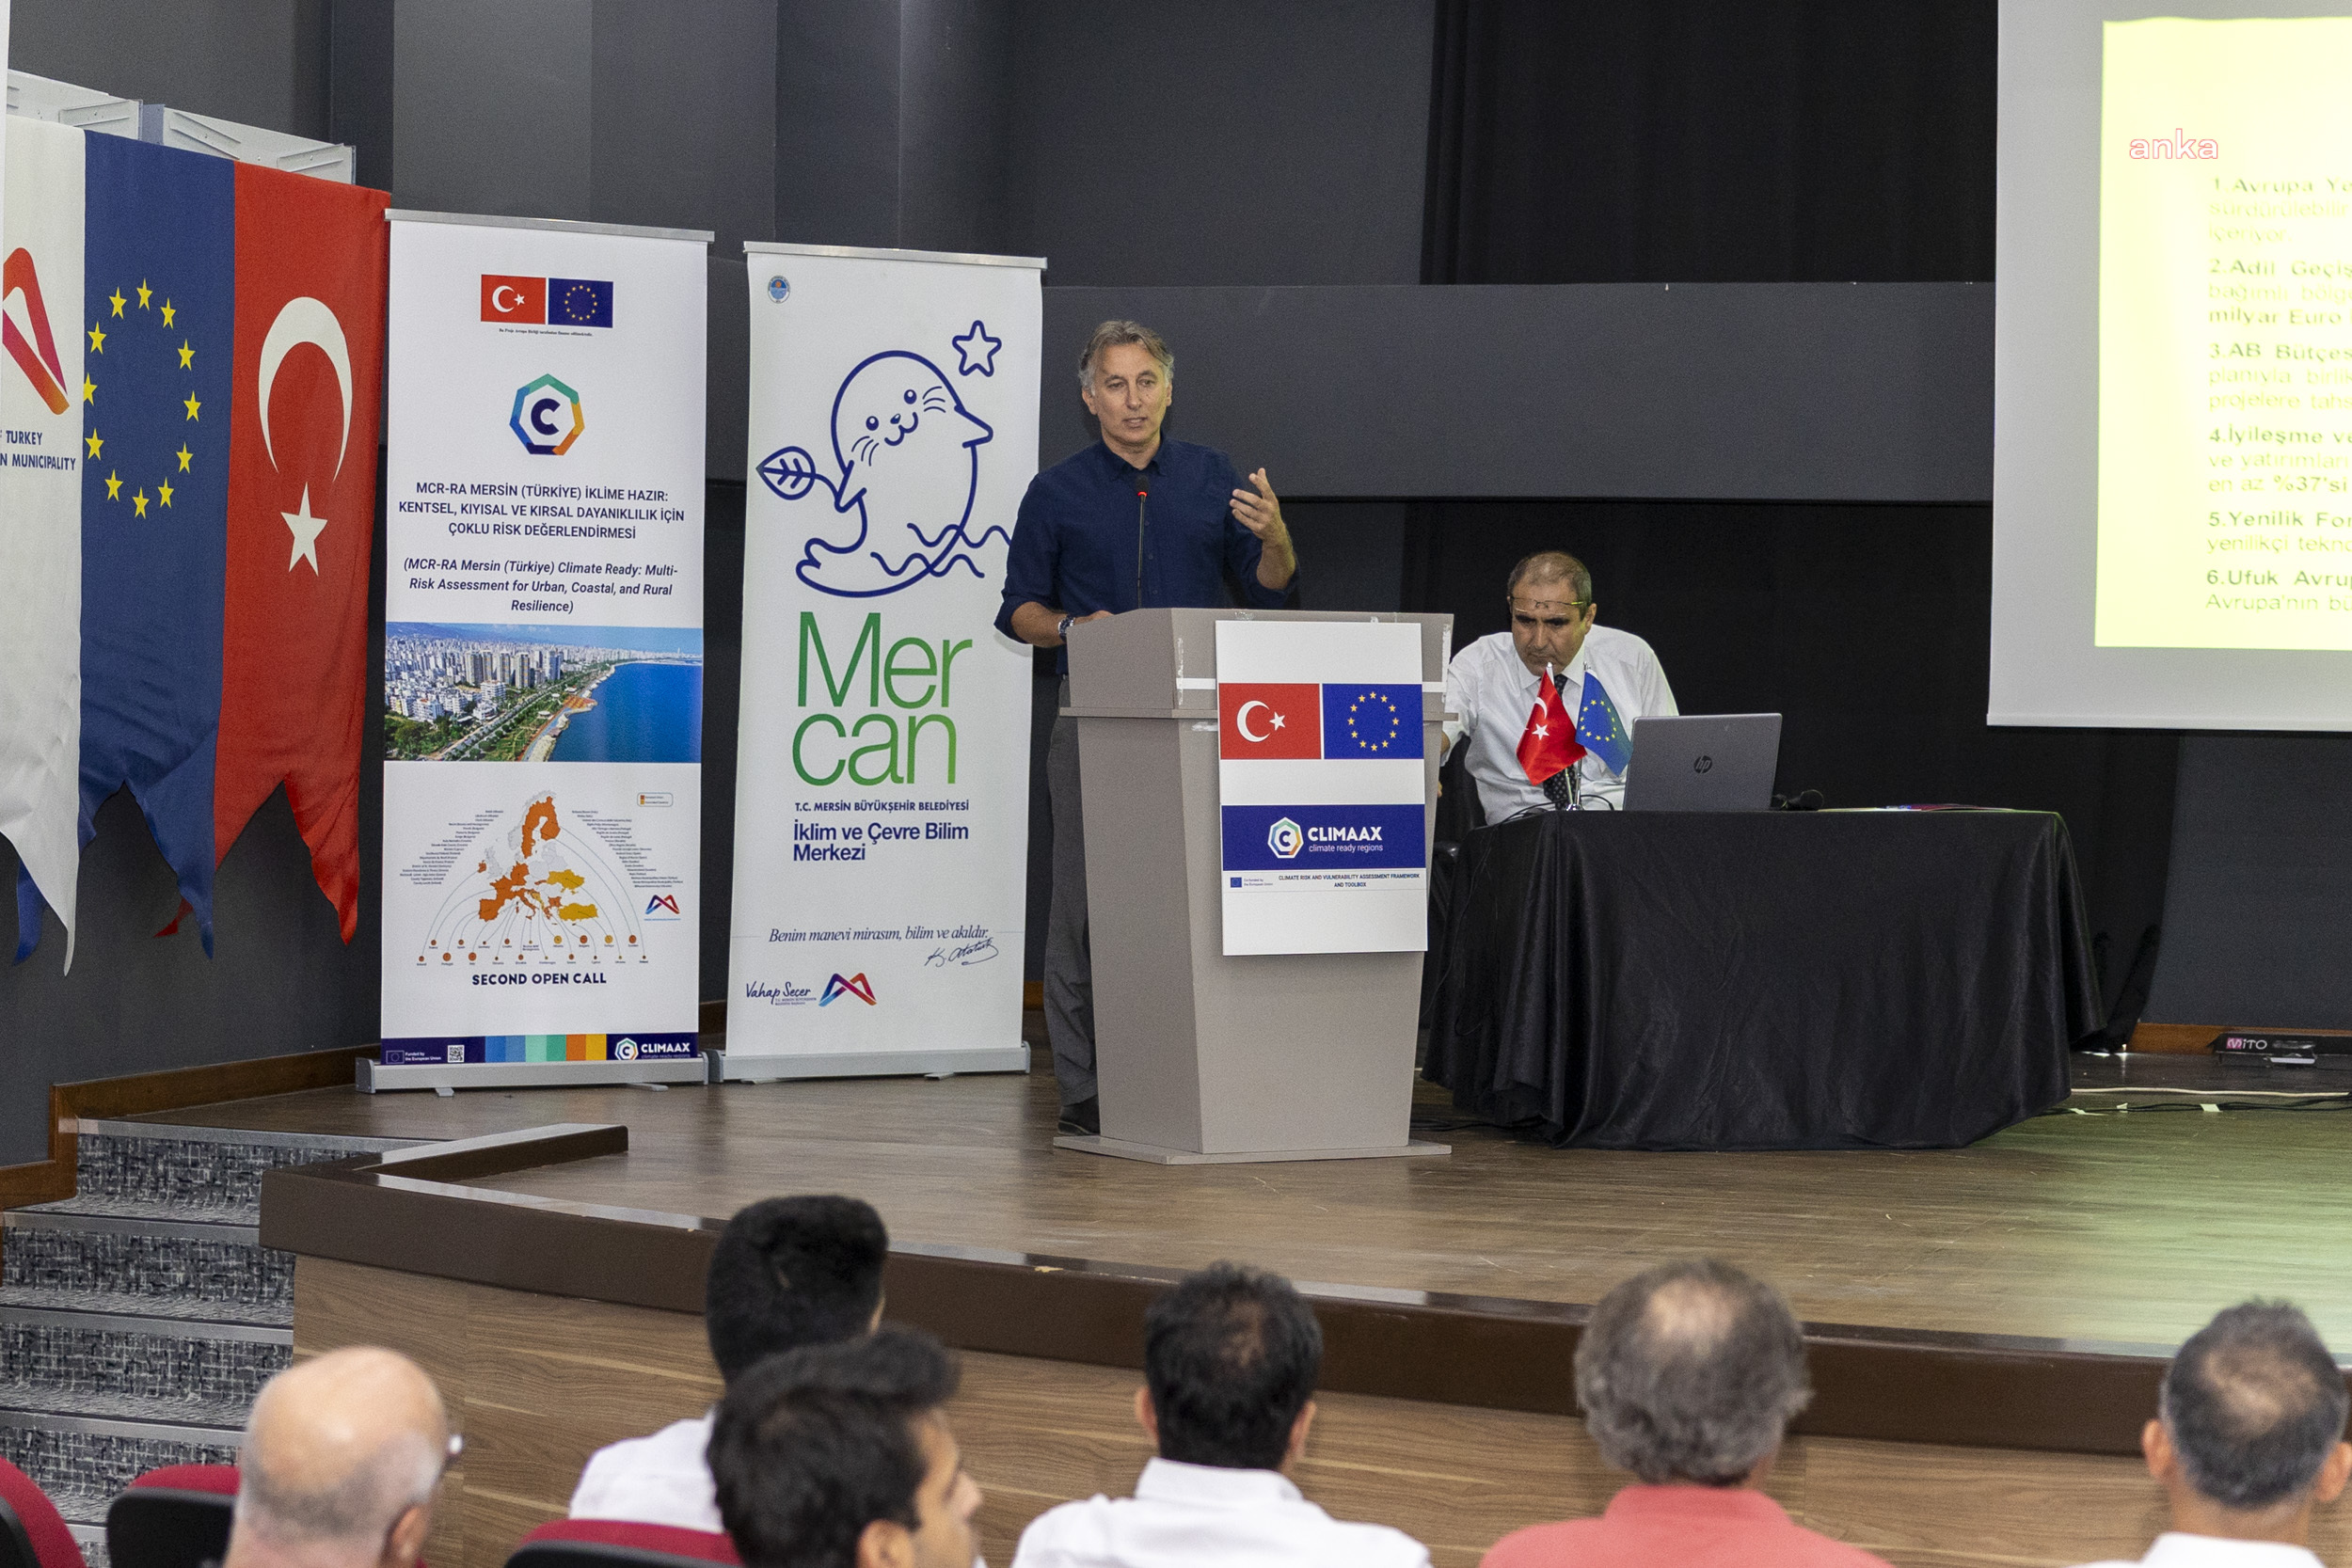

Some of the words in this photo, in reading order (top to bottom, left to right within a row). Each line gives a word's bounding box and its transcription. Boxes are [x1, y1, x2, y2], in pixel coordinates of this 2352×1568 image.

[2211, 175, 2314, 197] 1.Avrupa
[2209, 201, 2349, 218] sürdürülebilir
[2209, 257, 2276, 277] 2.Adil
[2209, 282, 2288, 303] bağımlı
[2209, 306, 2280, 326] milyar
[2289, 309, 2343, 325] Euro
[2209, 341, 2262, 359] 3.AB
[2209, 366, 2292, 387] planıyla
[2209, 390, 2300, 411] projelere
[6, 430, 42, 445] TURKEY
[2208, 423, 2323, 447] 4.İyileşme
[11, 453, 75, 470] MUNICIPALITY
[2208, 455, 2233, 467] ve
[2241, 451, 2348, 471] yatırımları
[416, 483, 467, 495] MCR-RA
[470, 483, 517, 496] MERSİN
[521, 483, 581, 500] (TÜRKİYE)
[585, 485, 625, 499] İKLİME
[628, 489, 668, 501] HAZIR:
[2208, 479, 2233, 492] en
[2241, 478, 2265, 491] az
[399, 501, 457, 516] KENTSEL,
[461, 503, 508, 515] KIYISAL
[511, 504, 527, 515] VE
[530, 506, 574, 517] KIRSAL
[577, 507, 658, 520] DAYANIKLILIK
[660, 508, 685, 523] İÇİN
[2208, 511, 2304, 528] 5.Yenilik
[448, 522, 489, 536] ÇOKLU
[493, 521, 521, 535] RİSK
[525, 523, 636, 539] DEĞERLENDİRMESİ
[2206, 534, 2288, 554] yenilikçi
[405, 557, 457, 572] (MCR-RA
[461, 560, 501, 572] Mersin
[504, 561, 555, 576] (Türkiye)
[558, 562, 602, 574] Climate
[605, 563, 642, 578] Ready:
[645, 564, 678, 576] Multi-
[409, 578, 435, 589] Risk
[437, 578, 510, 591] Assessment
[513, 579, 529, 592] for
[532, 581, 567, 594] Urban,
[572, 581, 617, 595] Coastal,
[619, 583, 640, 594] and
[644, 584, 673, 595] Rural
[2206, 569, 2279, 586] 6.Ufuk
[2294, 570, 2352, 589] Avru
[511, 600, 574, 614] Resilience)
[2205, 594, 2318, 613] Avrupa'nın
[798, 611, 973, 709] Mer
[792, 713, 957, 786] can
[1695, 755, 1711, 773] hp
[795, 802, 811, 812] T.C.
[814, 800, 851, 812] MERSİN
[854, 800, 915, 814] BÜYÜKŞEHİR
[918, 800, 969, 811] BELEDİYESİ
[794, 818, 836, 841] İklim
[842, 826, 863, 840] ve
[867, 822, 920, 845] Çevre
[926, 822, 969, 840] Bilim
[1308, 827, 1383, 841] CLIMAAX
[794, 843, 866, 862] Merkezi
[1336, 844, 1355, 854] ready
[1357, 844, 1383, 853] regions
[769, 928, 806, 942] Benim
[809, 927, 852, 941] manevi
[852, 927, 901, 942] mirasım,
[905, 926, 933, 939] bilim
[936, 929, 950, 939] ve
[951, 925, 989, 939] akıldır.
[472, 974, 528, 986] SECOND
[532, 973, 569, 984] OPEN
[573, 973, 607, 984] CALL
[747, 980, 781, 1005] Vahap
[641, 1042, 691, 1053] CLIMAAX
